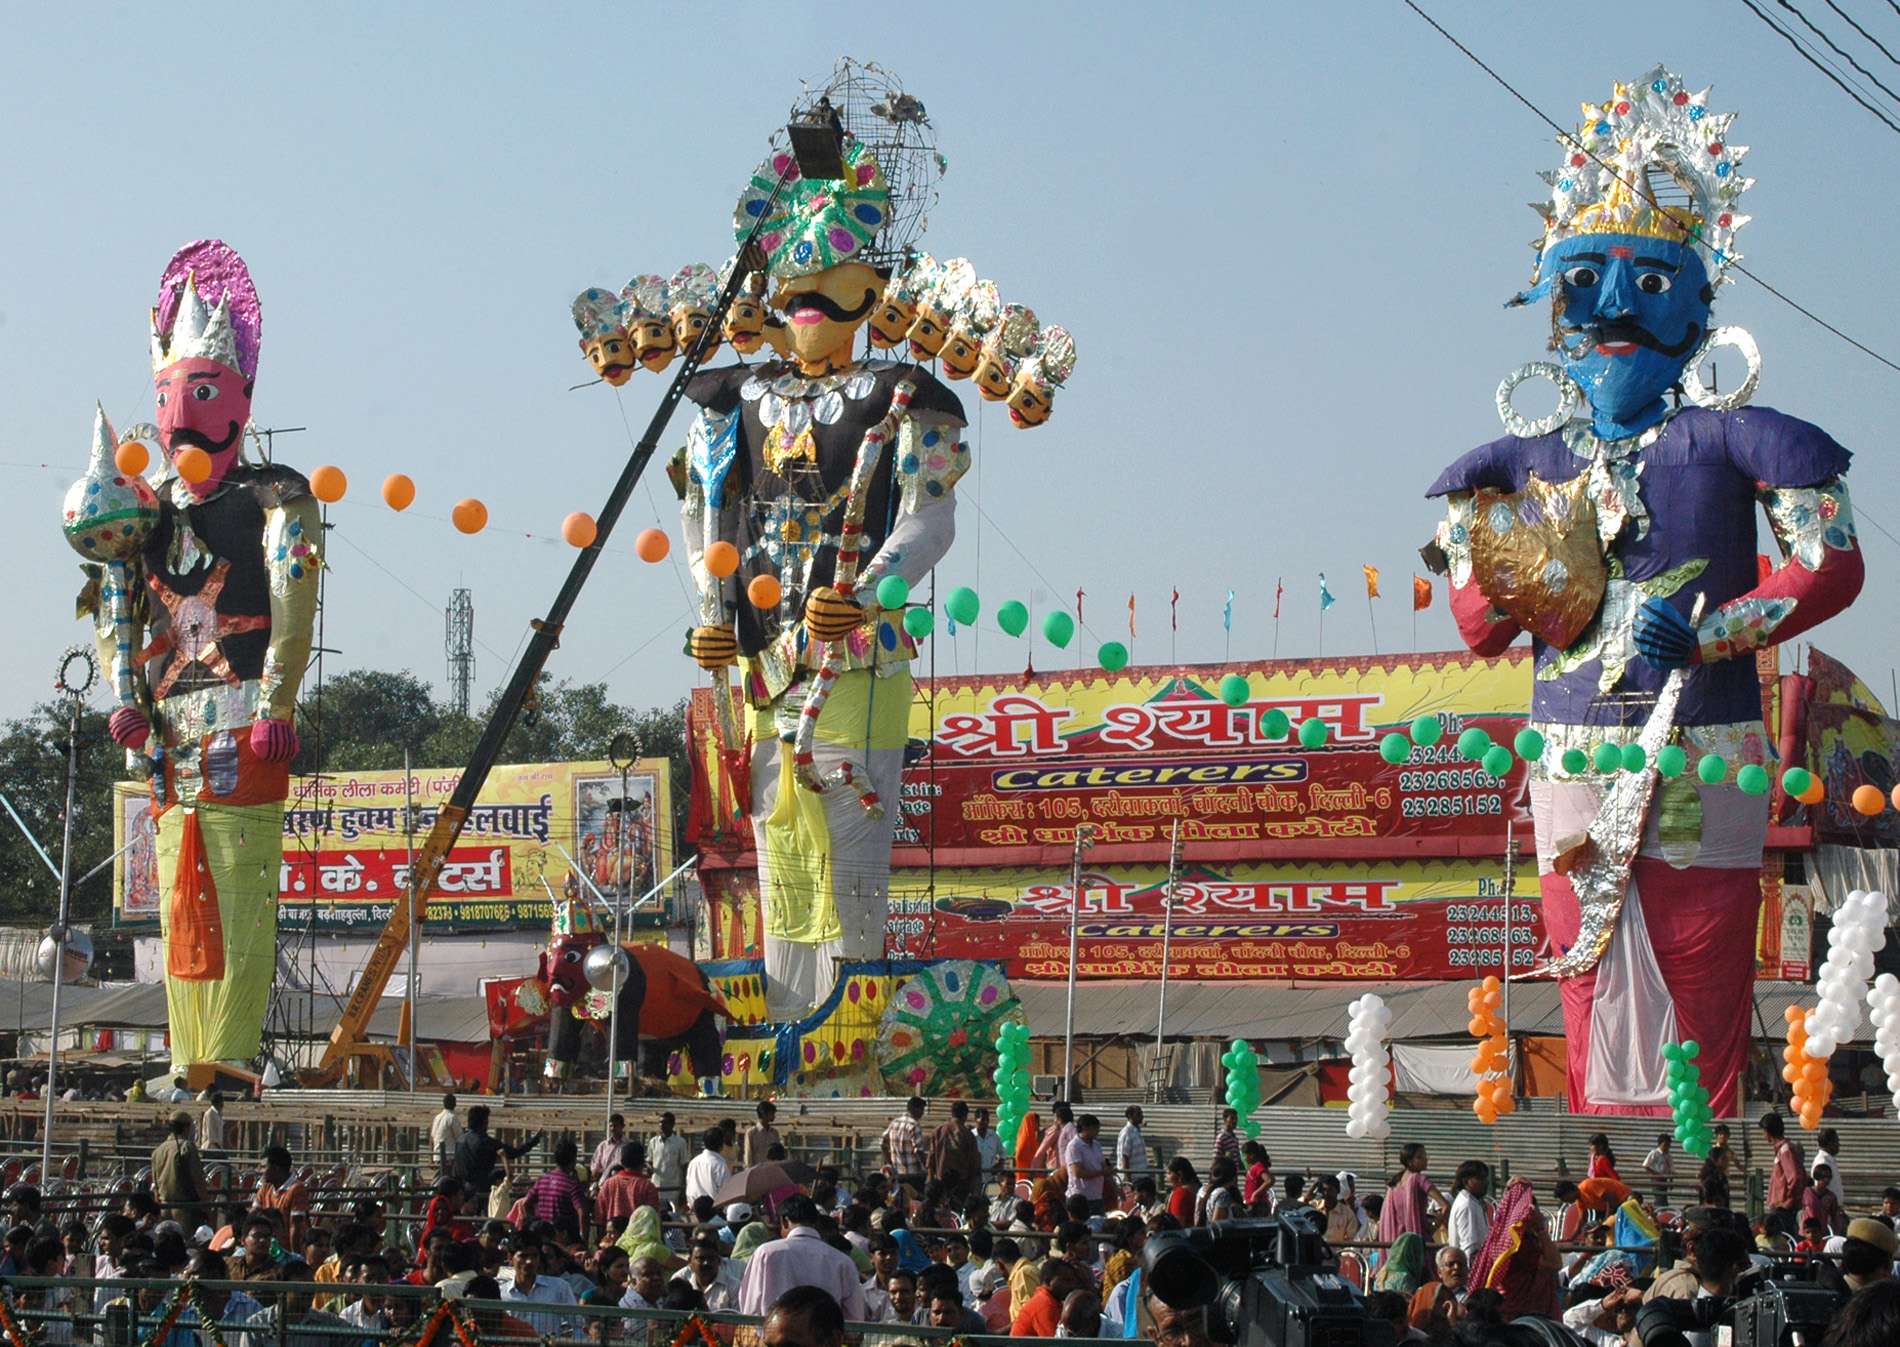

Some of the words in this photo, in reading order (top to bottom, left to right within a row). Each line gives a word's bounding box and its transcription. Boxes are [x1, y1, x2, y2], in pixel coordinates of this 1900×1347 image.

[937, 697, 1070, 756] श्री
[1101, 694, 1384, 750] श्याम
[1401, 743, 1498, 764] 3244
[341, 779, 377, 797] लीला
[380, 776, 420, 796] कमेटी
[1040, 798, 1089, 820] 105,
[1402, 797, 1502, 817] 23285152
[980, 825, 1028, 844] श्री
[1160, 820, 1260, 840] लीला
[1264, 816, 1377, 838] कमेटी
[319, 854, 379, 892] के.
[391, 847, 506, 895] टर्स
[1022, 872, 1138, 913] श्री
[1160, 880, 1403, 913] श्याम
[1090, 945, 1135, 960] 105,
